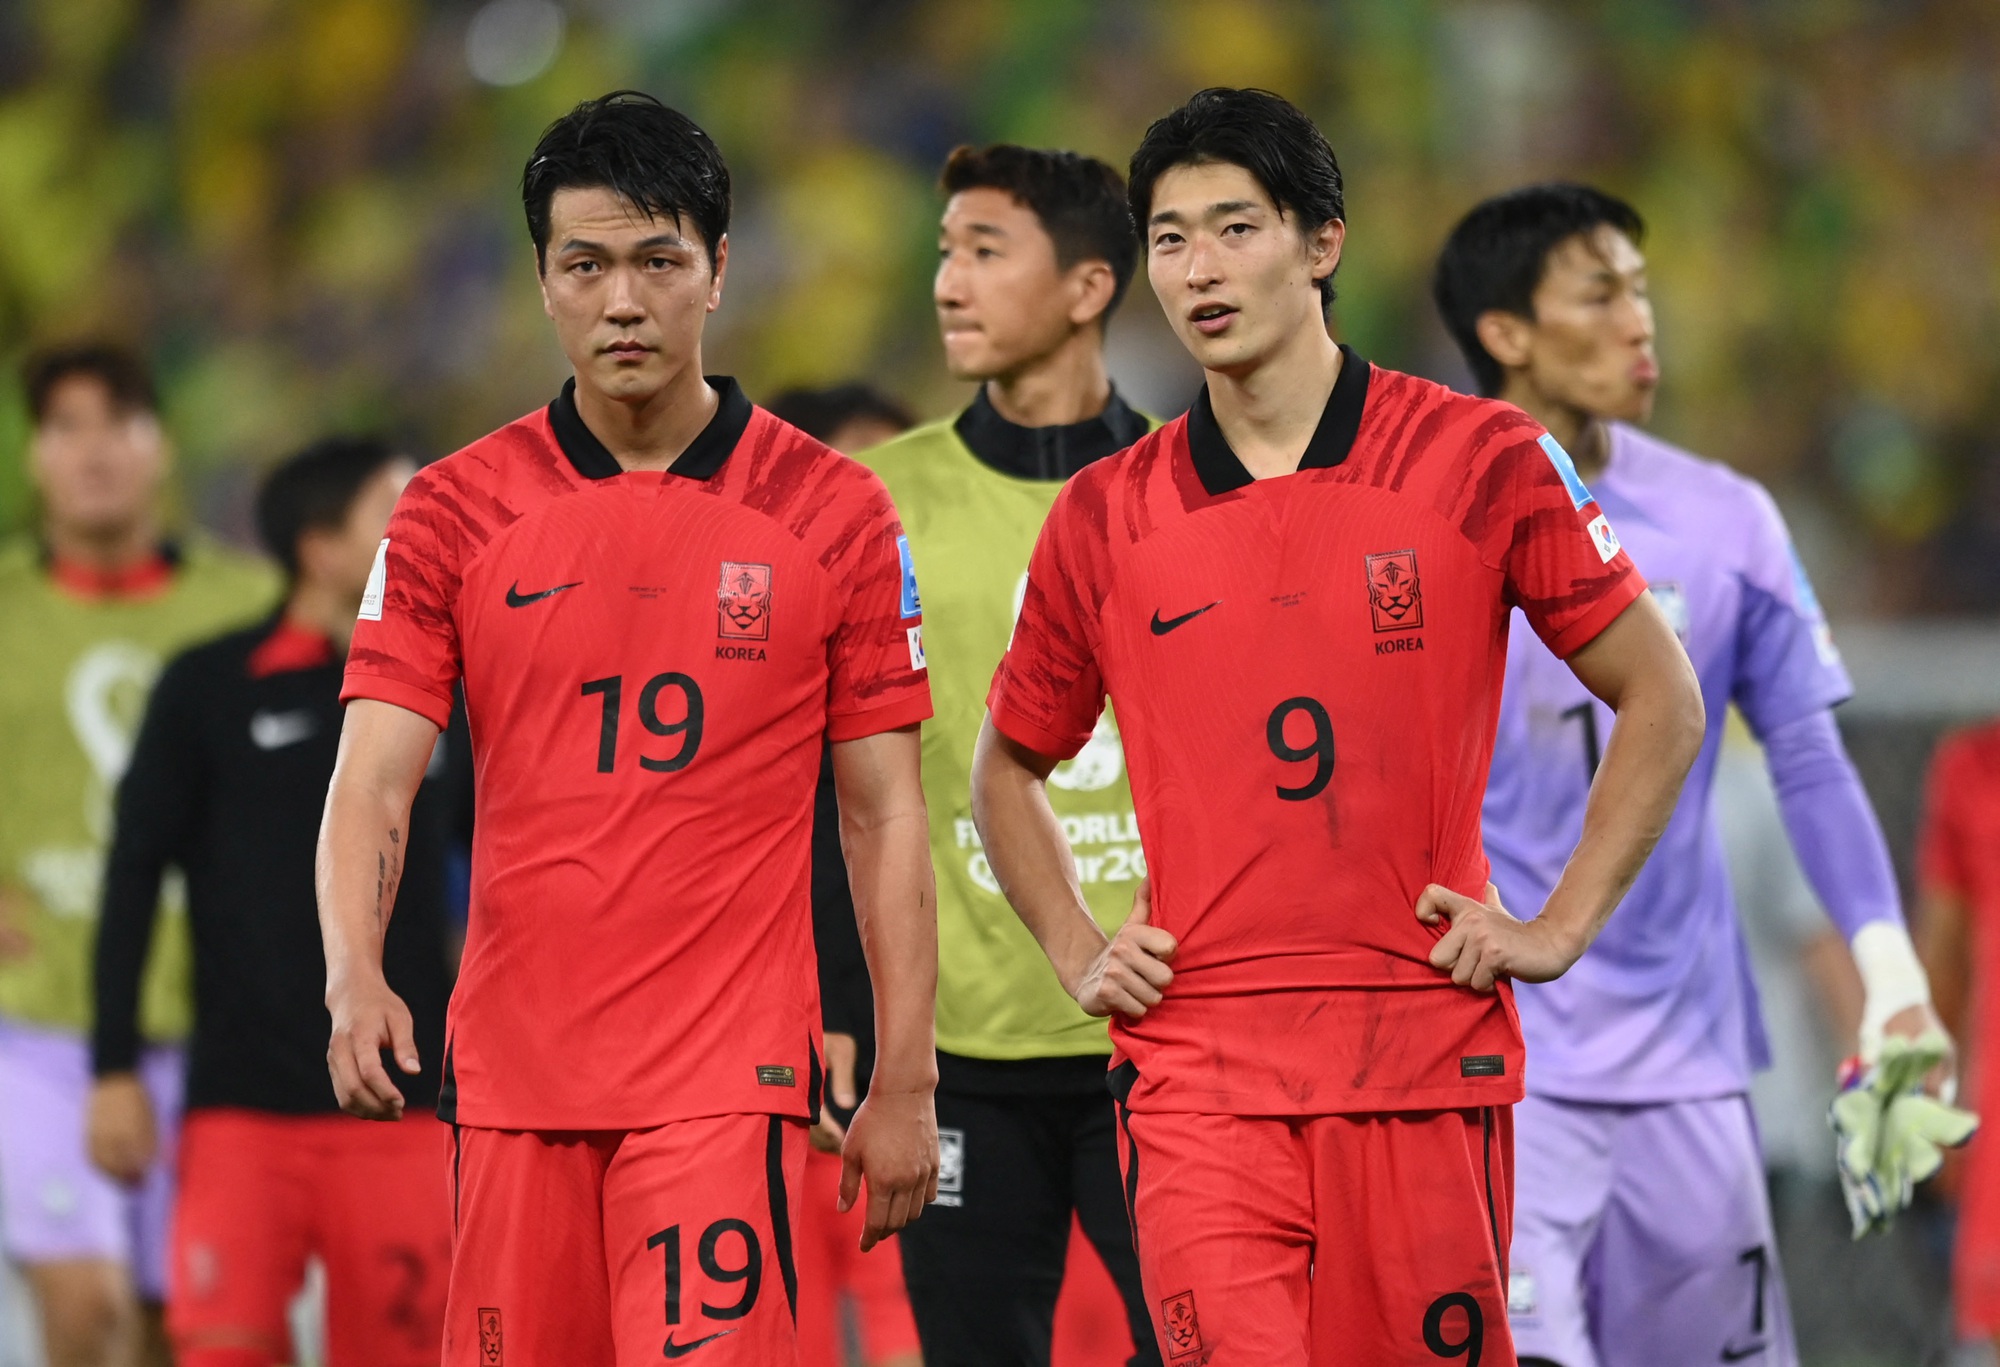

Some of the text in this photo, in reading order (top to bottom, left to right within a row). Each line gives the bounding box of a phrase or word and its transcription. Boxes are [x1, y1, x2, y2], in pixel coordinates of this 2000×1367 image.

[715, 646, 767, 662] KOREA
[1374, 637, 1424, 655] KOREA
[580, 671, 704, 773] 19
[1266, 696, 1335, 801] 9
[1560, 699, 1601, 788] 1
[646, 1218, 763, 1325] 19
[1736, 1244, 1766, 1336] 1
[1422, 1291, 1484, 1367] 9
